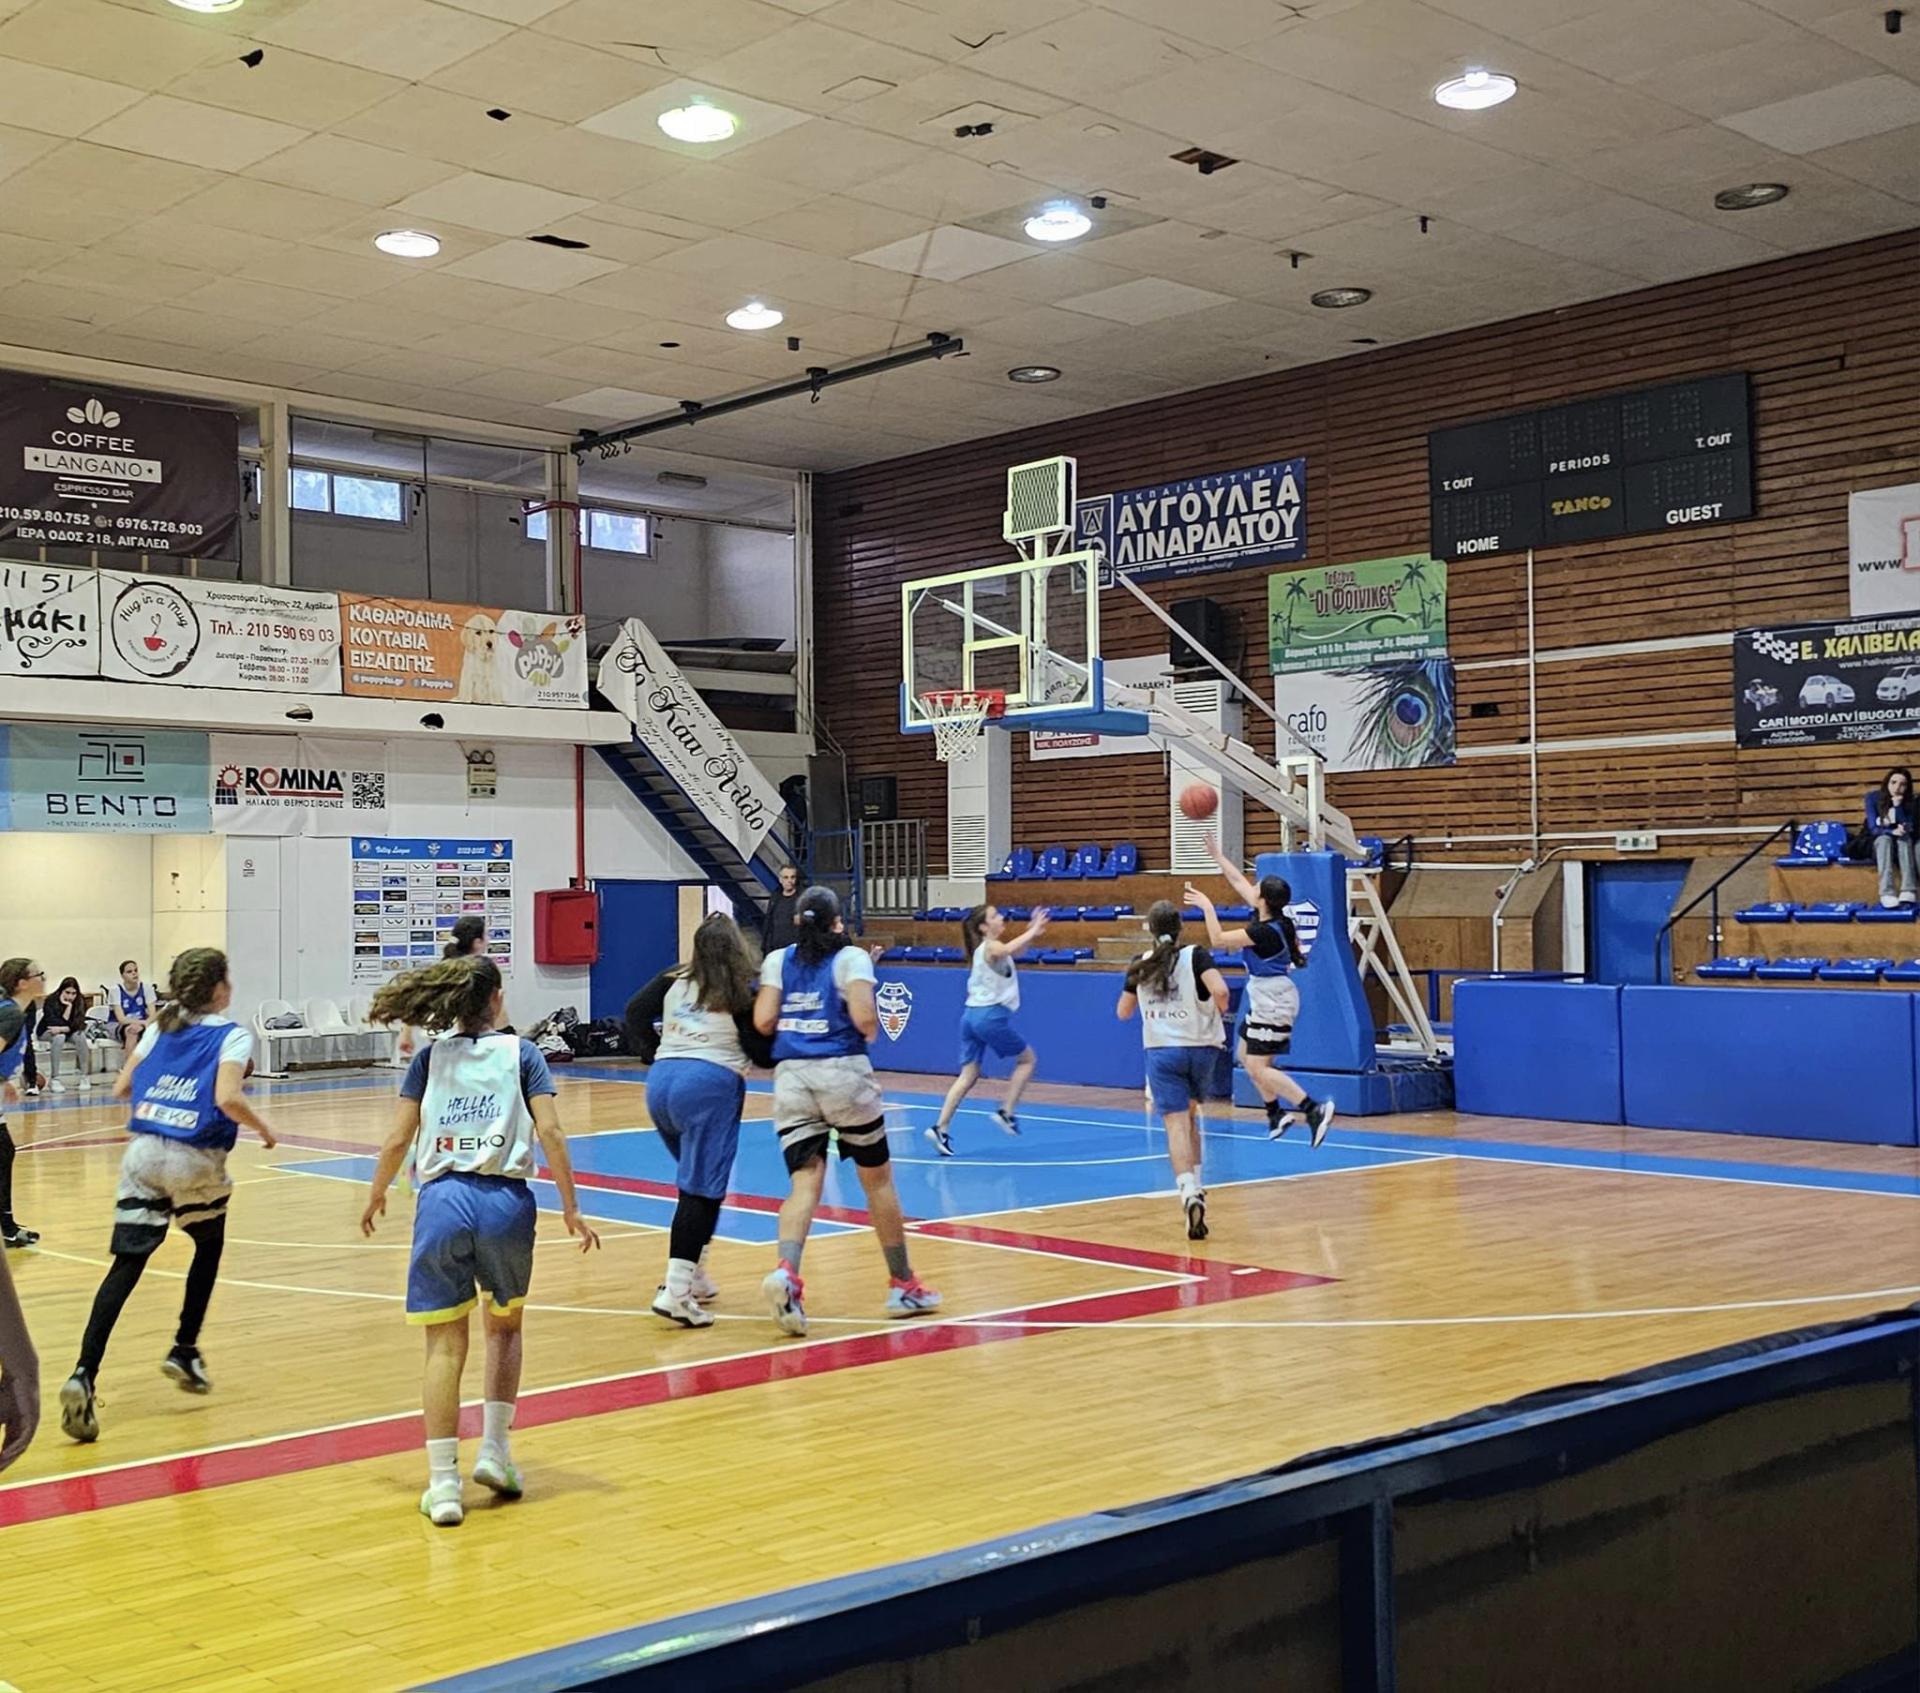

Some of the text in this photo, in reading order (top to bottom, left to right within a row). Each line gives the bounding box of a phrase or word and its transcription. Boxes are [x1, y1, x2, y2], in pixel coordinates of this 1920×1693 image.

[51, 430, 135, 453] COFFEE
[1707, 433, 1732, 447] OUT
[44, 453, 142, 477] LANGANO
[1550, 454, 1610, 473] PERIODS
[53, 483, 134, 498] ESPRESSO BAR
[1452, 477, 1474, 490] OUT
[1116, 474, 1300, 535] ΑΥΓΟΥΛΕΑ
[1666, 503, 1723, 525] GUEST
[116, 517, 203, 535] 6976.728.903
[1116, 506, 1300, 565] ΛΙΝΑΡΔΑΤΟΥ
[17, 527, 169, 550] ΙΕΡΑ ΟΔΟΣ 218, ΑΙΓΑΛΕΩ
[1457, 536, 1499, 555] HOME
[120, 600, 141, 622] Hug
[349, 604, 455, 632] ΚΑΘΑΡΟΑΙΜΑ
[247, 622, 270, 637] 210
[273, 624, 297, 640] 590
[299, 628, 316, 642] 69
[319, 629, 335, 642] 03
[349, 626, 429, 651] ΚΟΥΤΑΒΙΑ
[349, 649, 436, 674] ΕΙΣΑΓΩΓΗΣ
[245, 767, 343, 795] ROMINA
[46, 793, 176, 816] BENTO
[284, 800, 344, 809] ΘΕΡΜΟΣΙΦΩΝΕΣ
[1158, 1010, 1188, 1019] EKO
[448, 1093, 495, 1111] HELLAS
[154, 1107, 196, 1125] EKO
[459, 1134, 505, 1150] EKO
